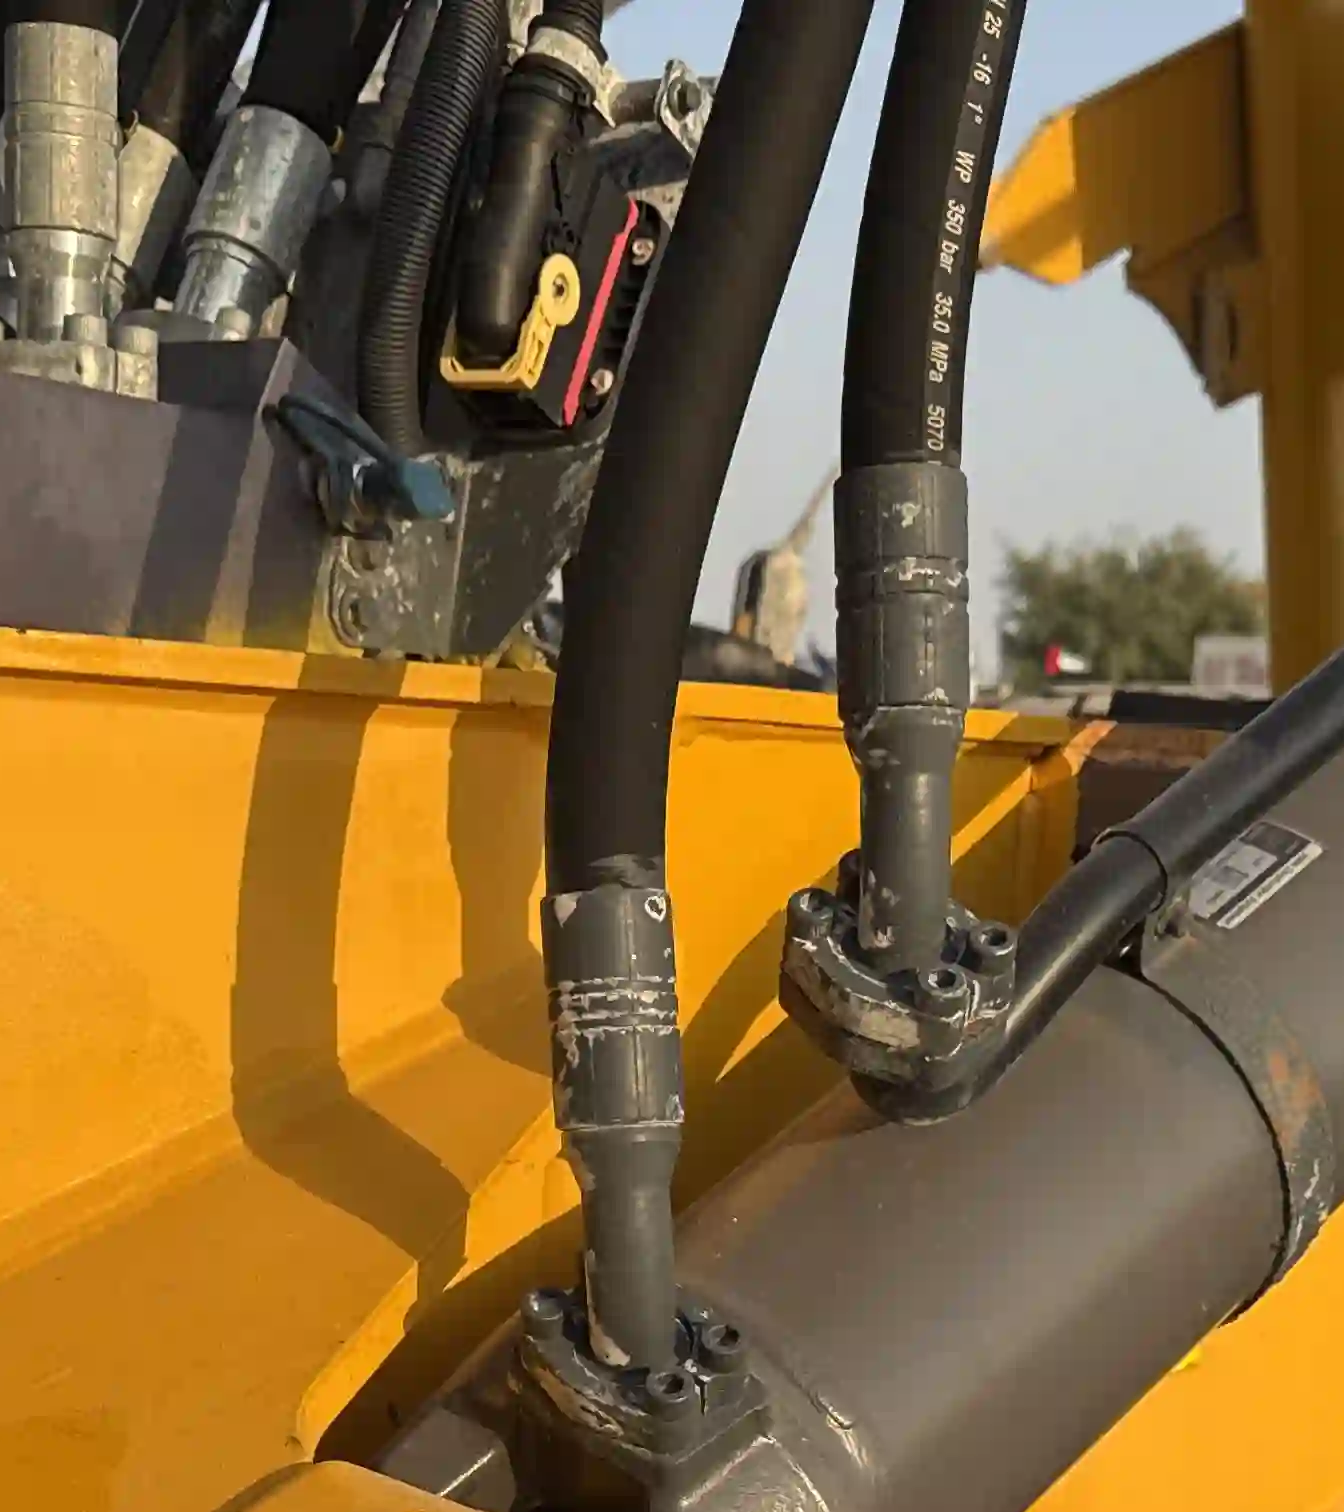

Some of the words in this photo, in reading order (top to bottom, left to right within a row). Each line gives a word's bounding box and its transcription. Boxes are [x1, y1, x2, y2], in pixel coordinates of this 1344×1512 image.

[983, 10, 1003, 39] 25
[973, 53, 993, 86] -16
[955, 150, 976, 184] WP
[944, 199, 966, 236] 350
[939, 240, 959, 274] bar
[932, 291, 953, 334] 35.0
[928, 340, 949, 383] MPa
[927, 404, 945, 451] 5070
